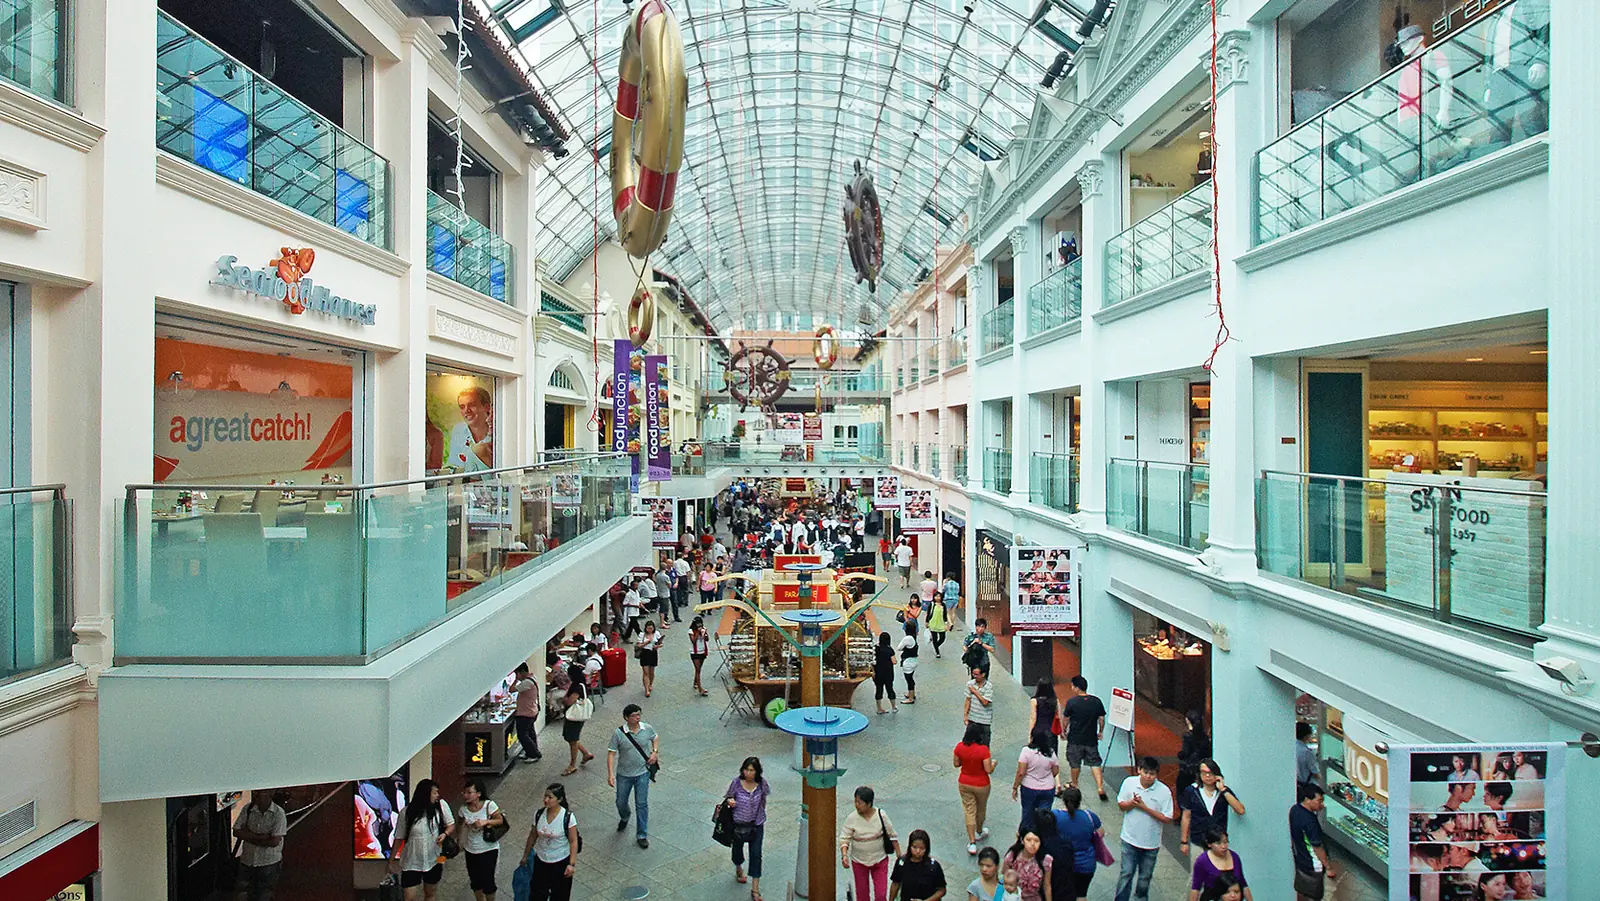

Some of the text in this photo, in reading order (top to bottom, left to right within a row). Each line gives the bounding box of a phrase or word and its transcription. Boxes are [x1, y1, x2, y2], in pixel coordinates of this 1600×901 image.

[213, 254, 313, 308] Seafood
[615, 372, 628, 460] oodjunction
[648, 382, 659, 460] foodjunction
[1410, 481, 1462, 512] SKN
[1452, 528, 1476, 542] 1957
